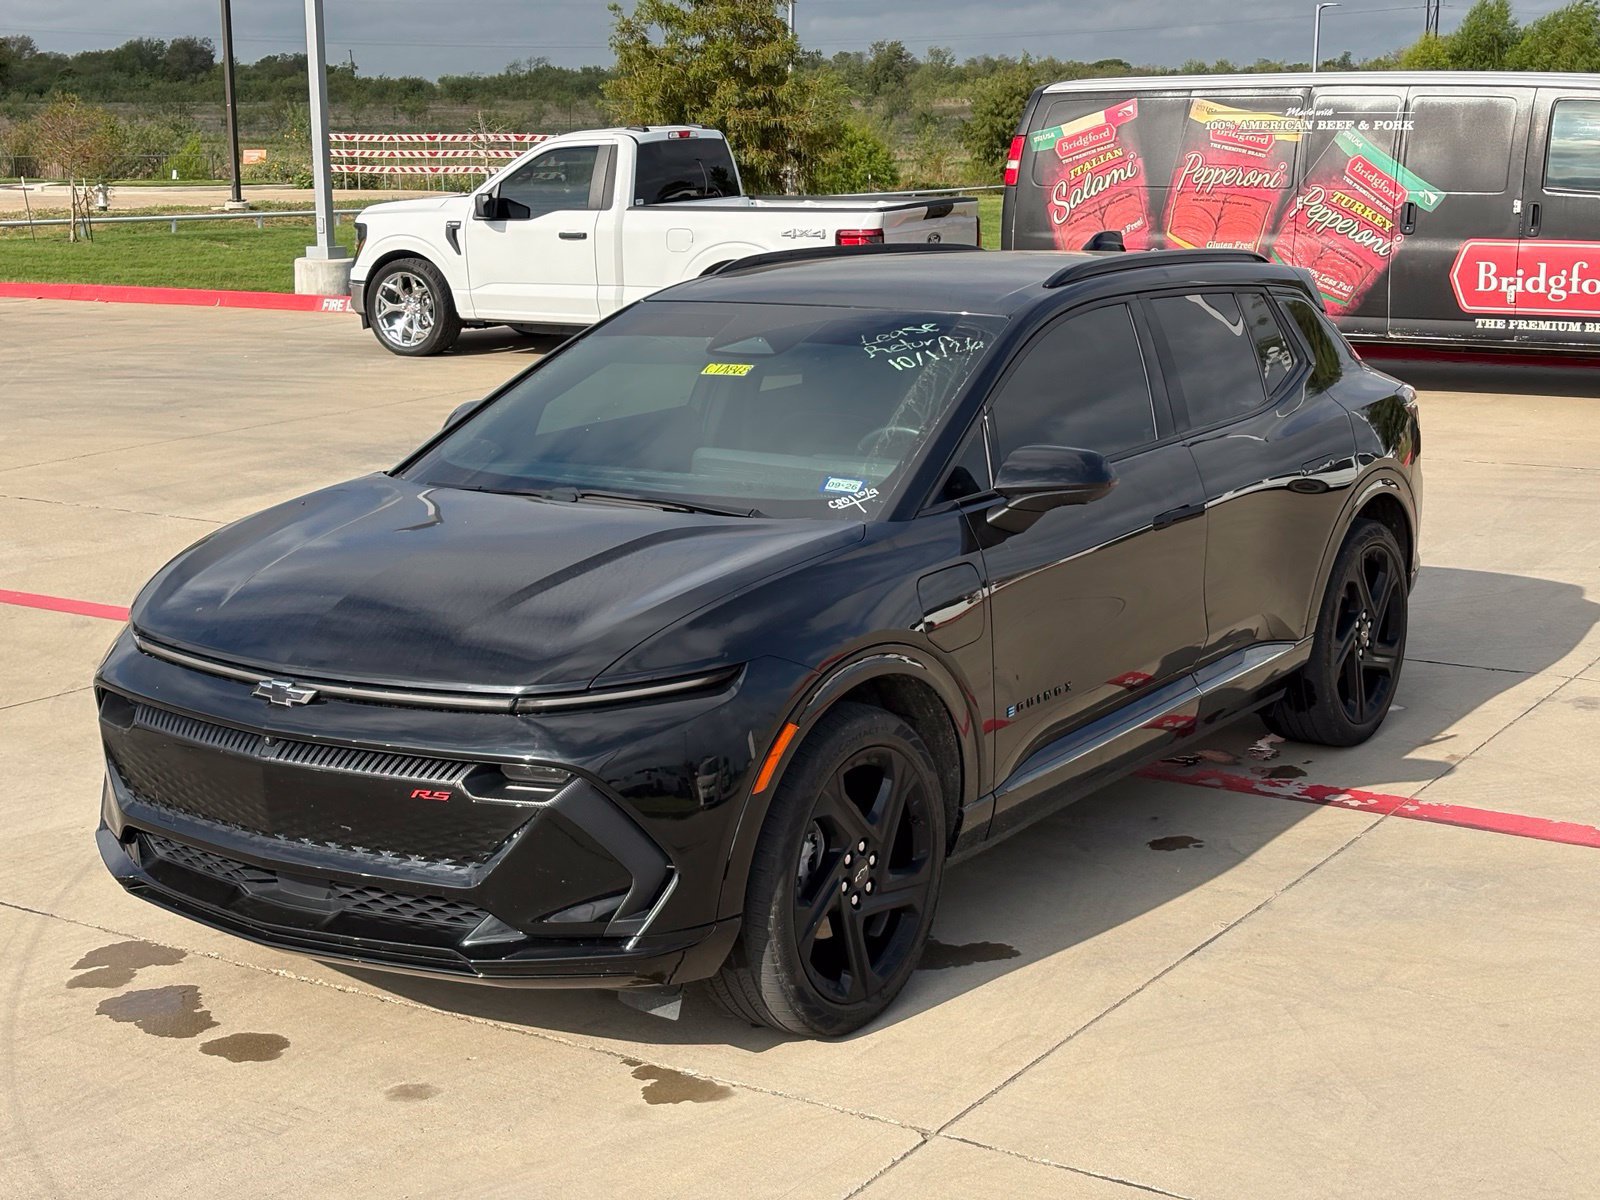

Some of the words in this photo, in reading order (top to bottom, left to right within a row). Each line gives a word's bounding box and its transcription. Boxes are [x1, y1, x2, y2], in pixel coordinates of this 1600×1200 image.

[1285, 107, 1314, 117] Made
[1315, 108, 1334, 116] with
[1205, 121, 1236, 130] 100%
[1239, 120, 1314, 130] AMERICAN
[1317, 120, 1355, 130] BEEF
[1358, 120, 1369, 130] &
[1373, 120, 1415, 131] PORK
[1061, 127, 1110, 152] Bridgford
[1069, 147, 1123, 180] ITALIAN
[1177, 153, 1285, 194] Pepperoni
[1352, 161, 1403, 202] Bridgford
[1052, 153, 1137, 225] Salami
[1289, 186, 1402, 256] Pepperoni
[1329, 191, 1394, 233] TURKEY
[1206, 241, 1233, 249] Gluten
[1234, 241, 1255, 250] Free!
[1319, 273, 1338, 286] Less
[321, 298, 345, 311] FIRE
[1475, 318, 1506, 329] THE
[1508, 319, 1582, 332] PREMIUM
[410, 788, 452, 801] RS
